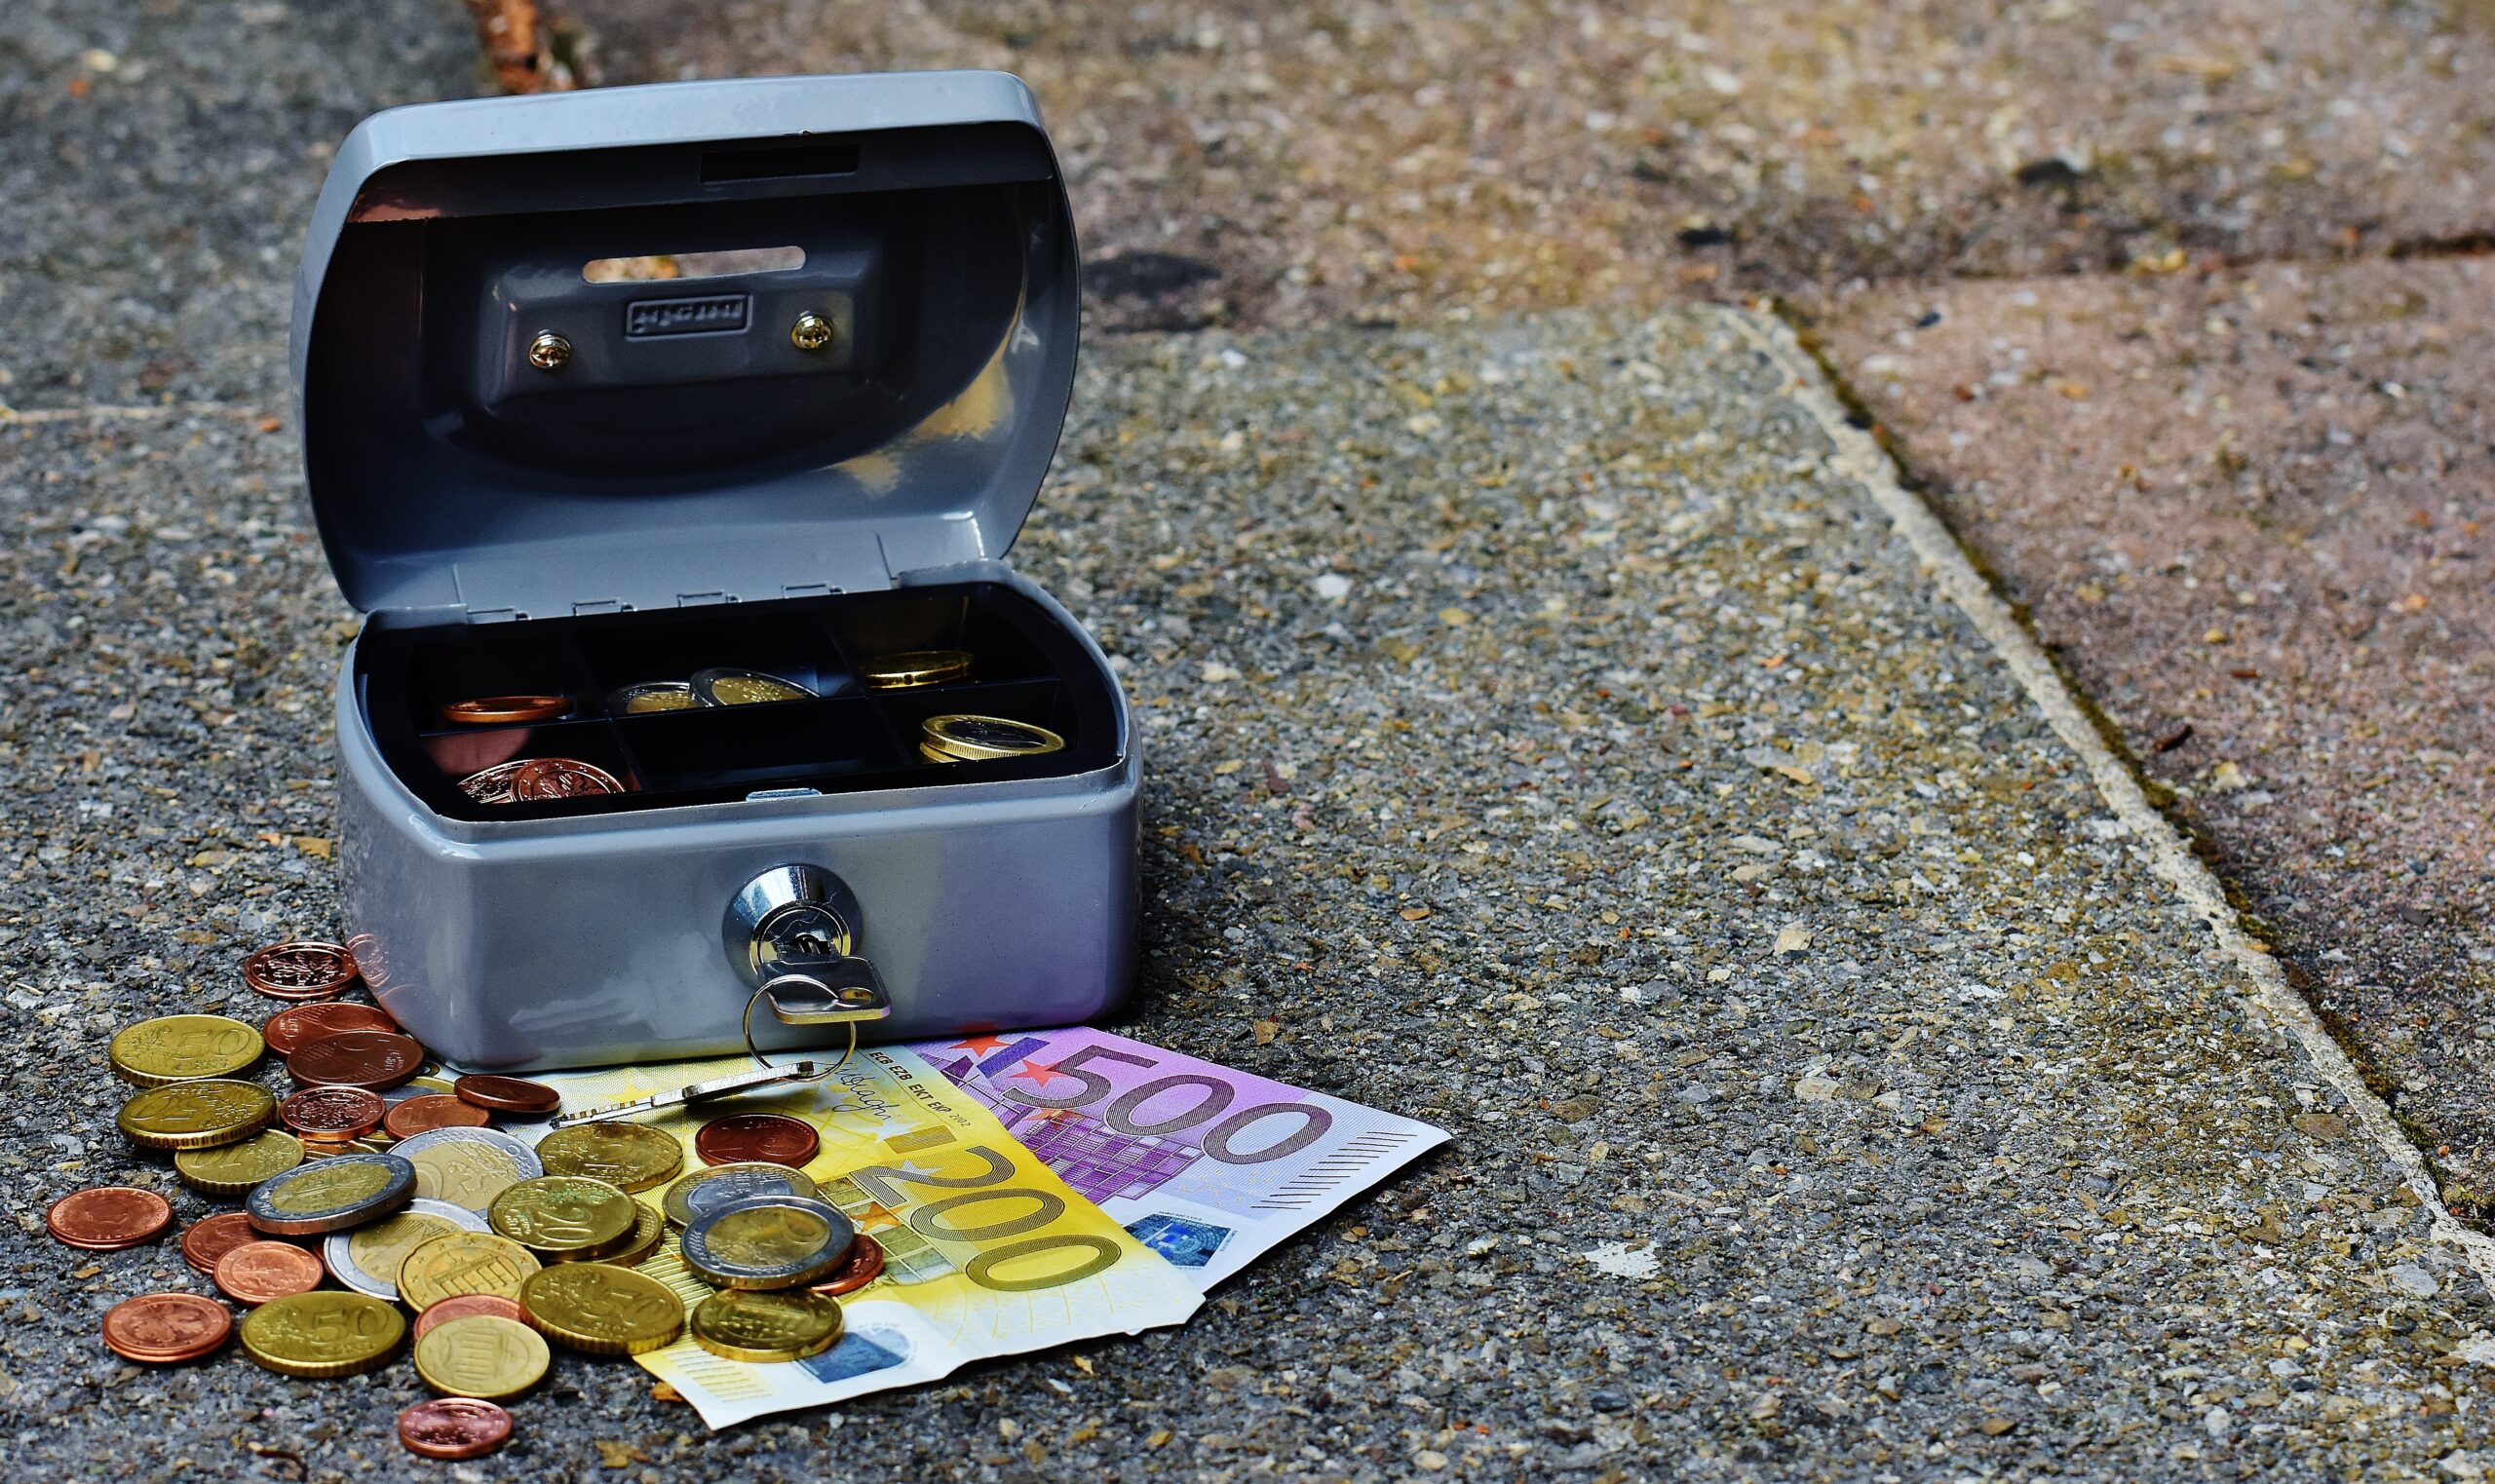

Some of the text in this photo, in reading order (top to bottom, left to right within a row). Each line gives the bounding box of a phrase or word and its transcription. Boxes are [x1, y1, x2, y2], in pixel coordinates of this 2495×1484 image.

[173, 1029, 251, 1060] 50
[869, 1051, 894, 1065] ECB
[889, 1065, 913, 1081] EZB
[907, 1084, 934, 1100] EKT
[949, 1114, 972, 1127] 2002
[1001, 1045, 1333, 1164] 500
[534, 1207, 596, 1243] 20
[849, 1145, 1122, 1291] 200
[311, 1306, 390, 1344] 50
